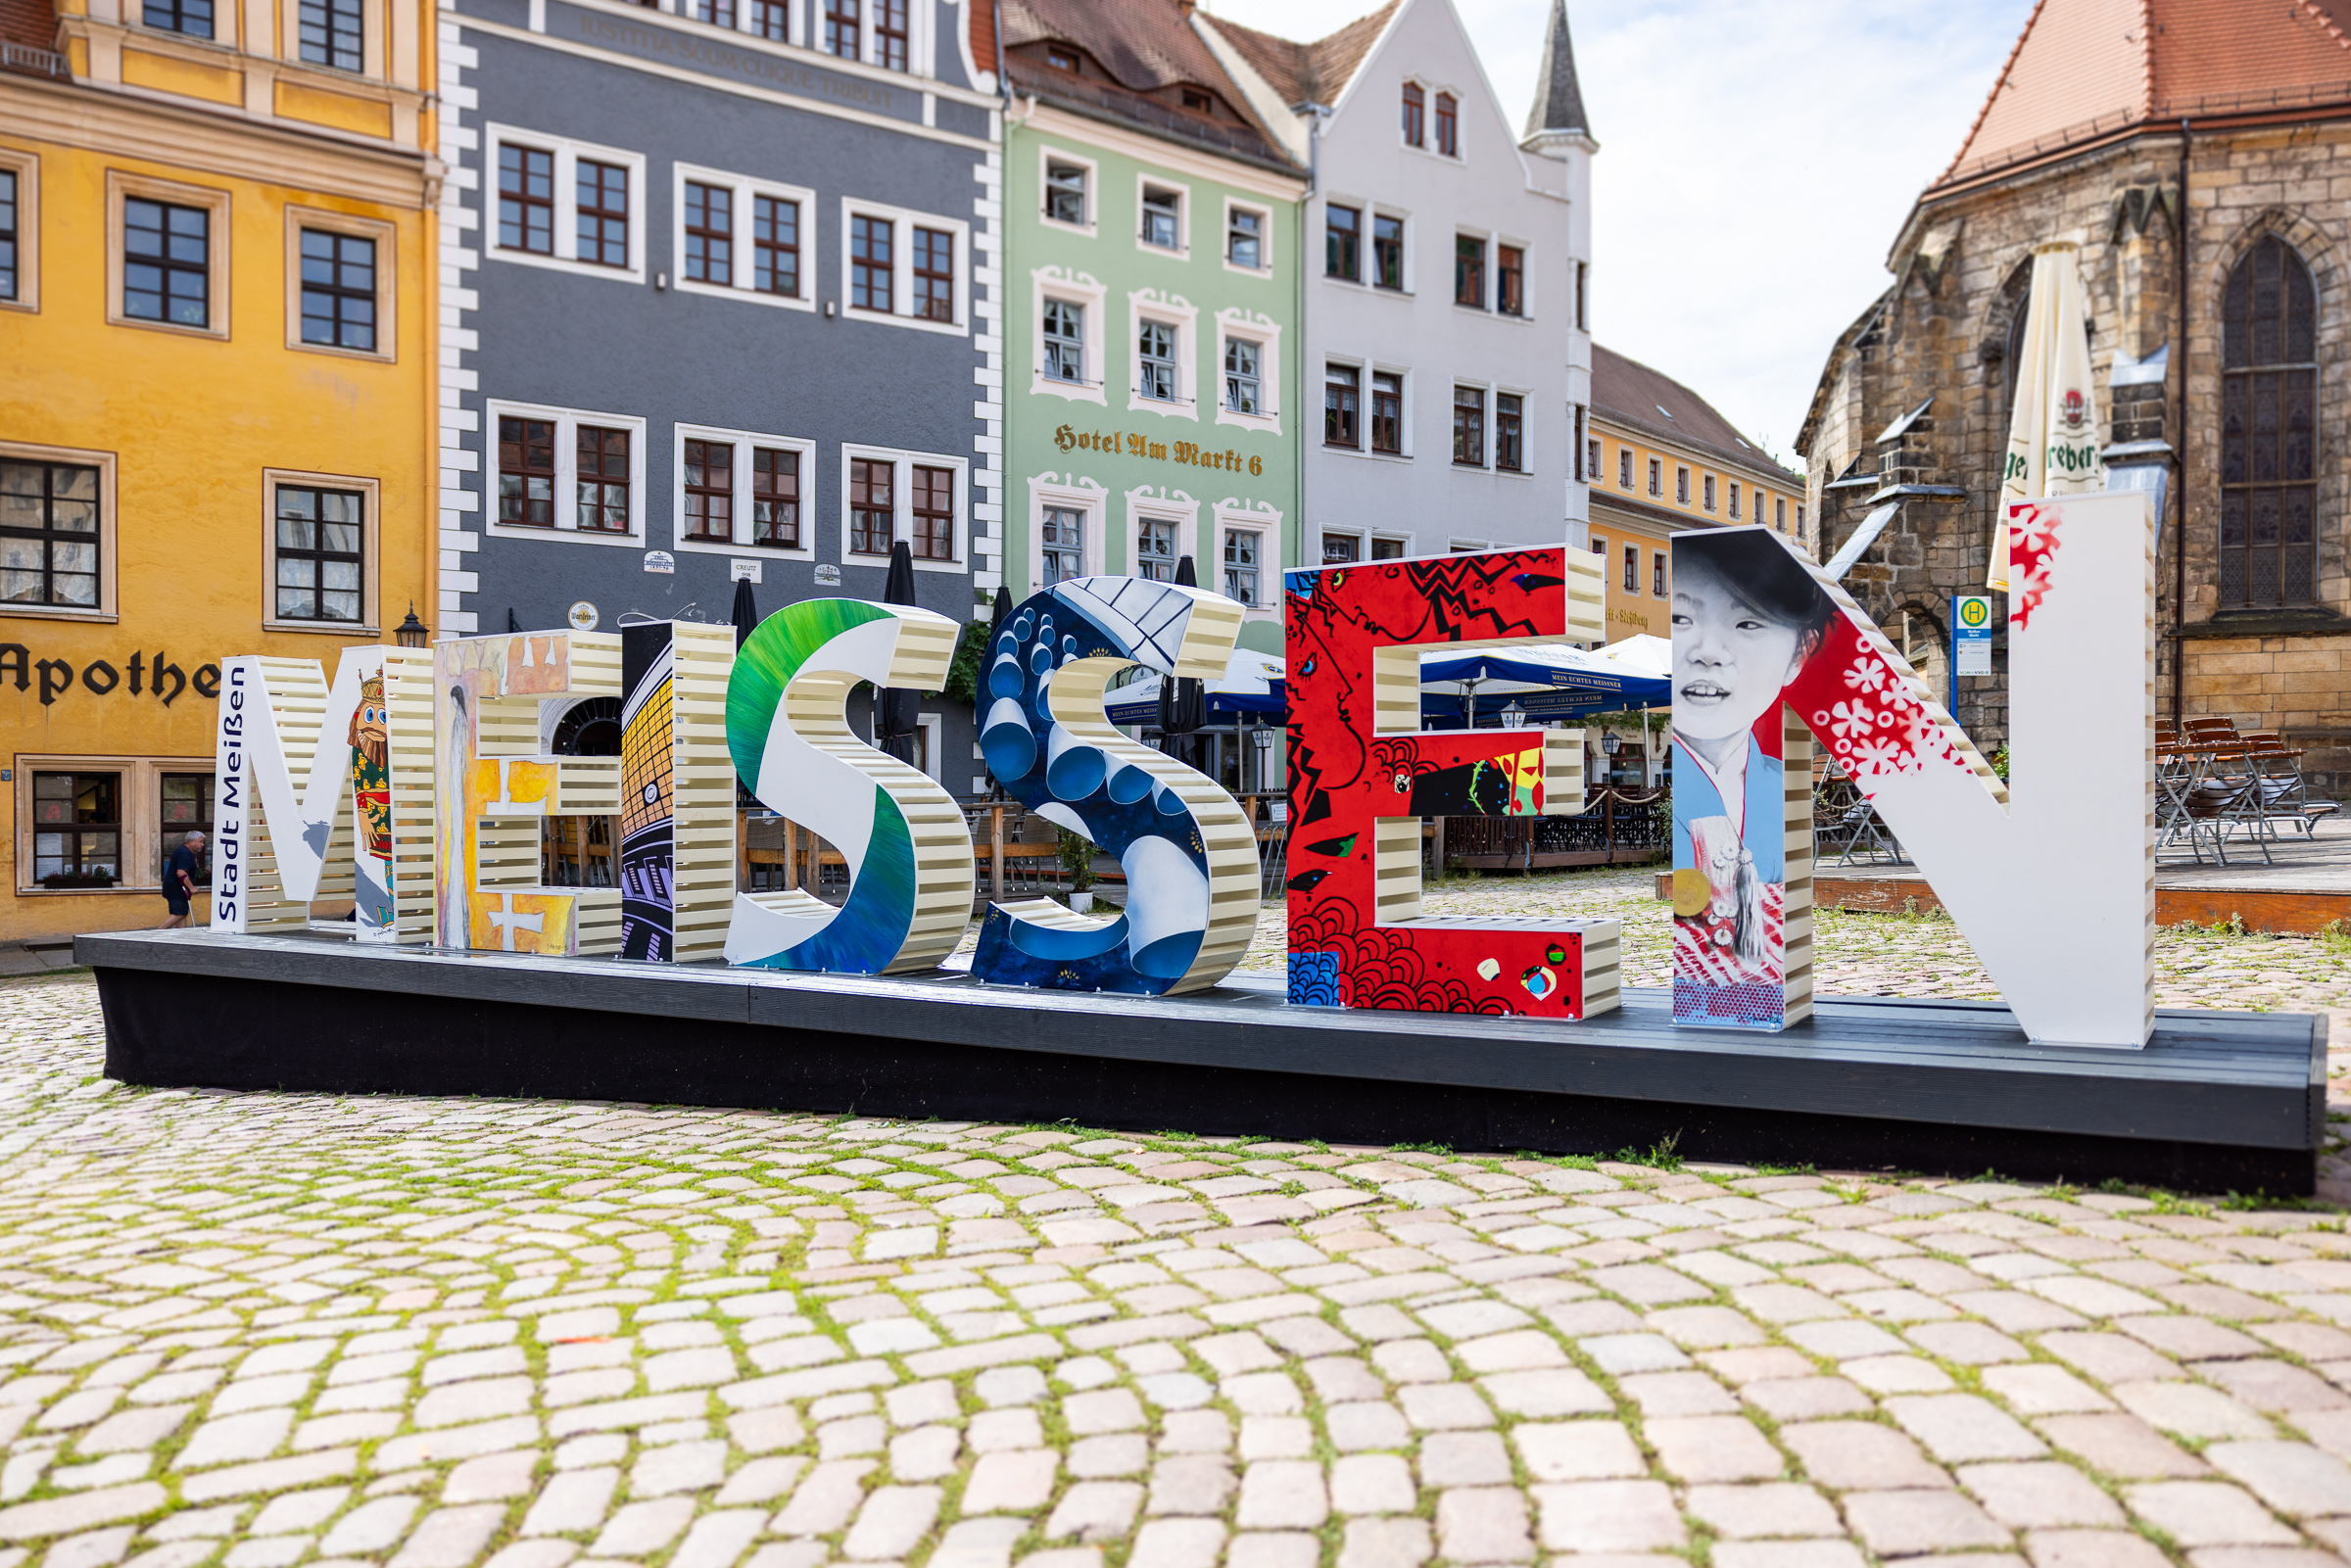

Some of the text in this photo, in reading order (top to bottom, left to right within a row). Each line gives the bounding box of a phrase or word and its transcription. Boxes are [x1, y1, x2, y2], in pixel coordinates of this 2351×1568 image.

[678, 38, 738, 71] SUUM
[742, 55, 815, 90] CUIQUE
[1054, 423, 1263, 476] Hotel Am Markt 6
[1968, 604, 1980, 621] H
[0, 643, 221, 708] Apothe
[1593, 679, 1622, 688] MEISSNER
[212, 493, 2159, 1048] MEISSEN
[218, 666, 245, 923] Stadt Meißen
